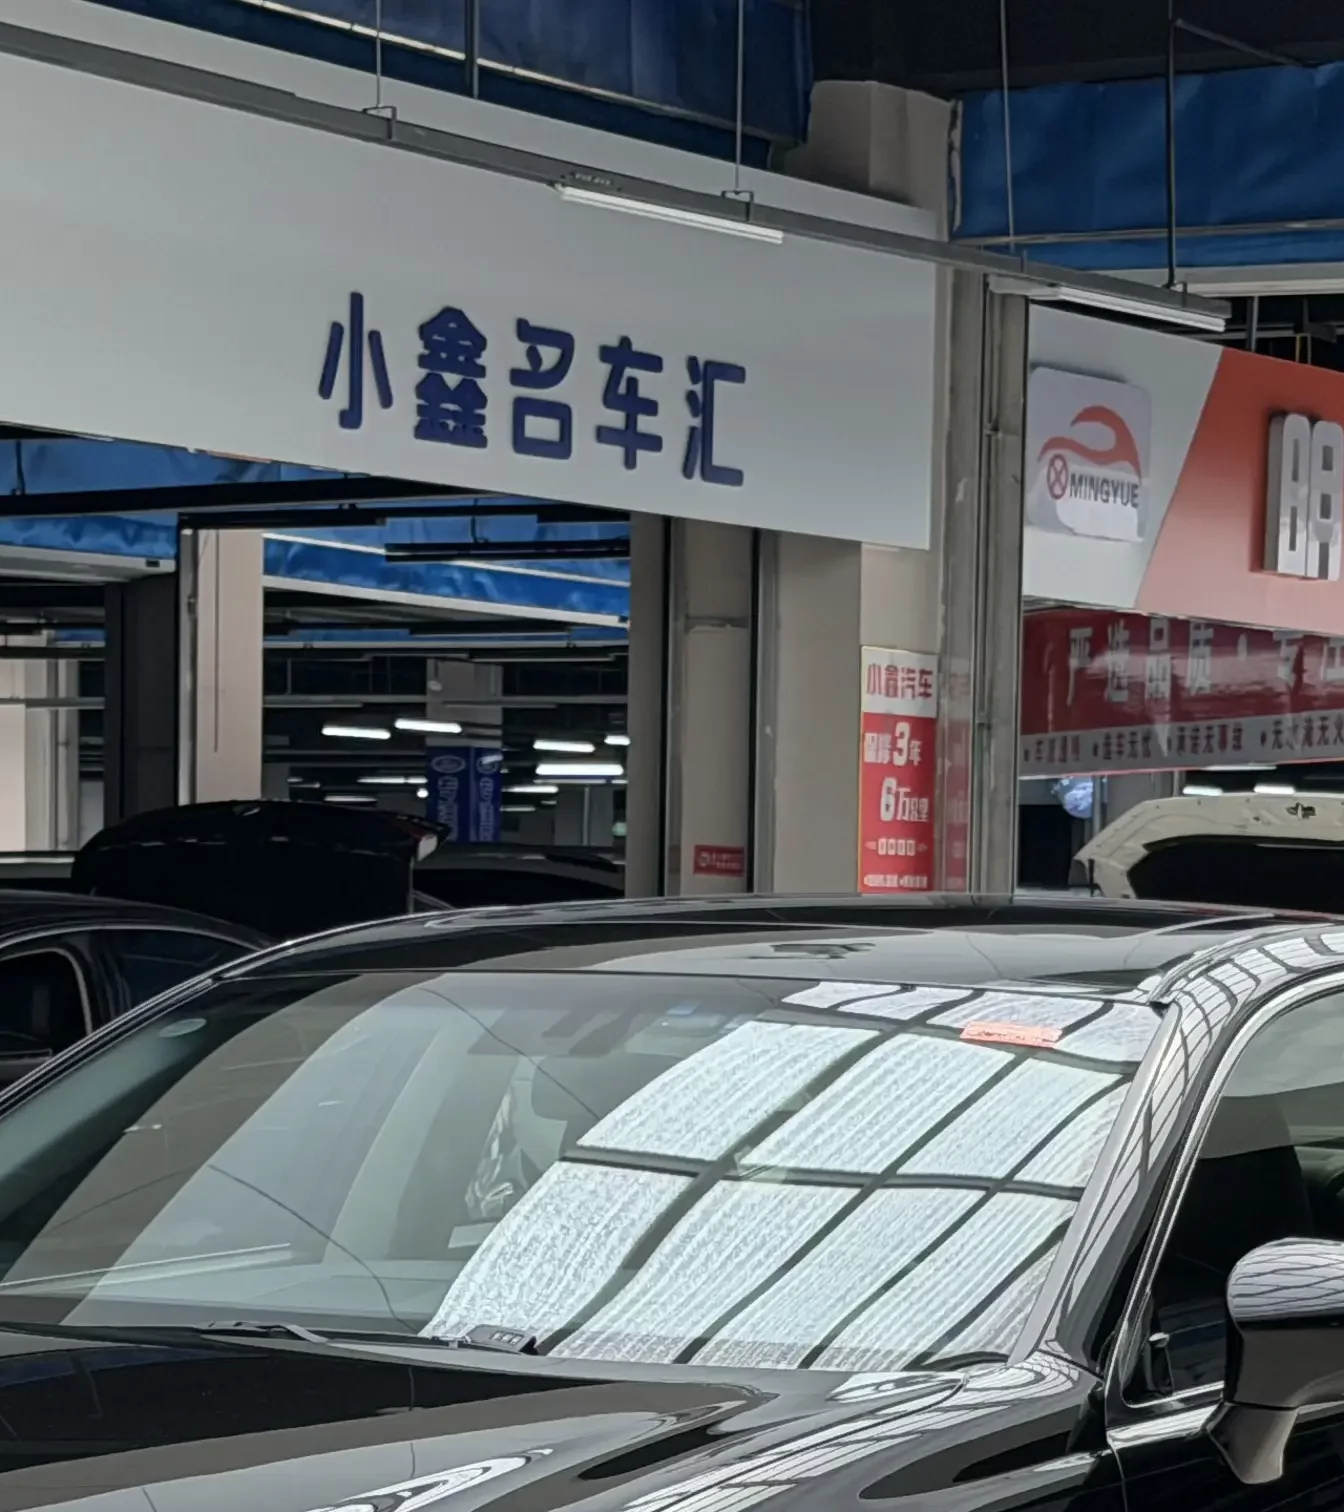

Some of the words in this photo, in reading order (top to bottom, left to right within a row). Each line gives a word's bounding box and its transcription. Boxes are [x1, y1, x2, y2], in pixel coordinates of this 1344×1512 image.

[318, 291, 746, 486] 小鑫名车汇
[1068, 471, 1139, 508] MINGYUE
